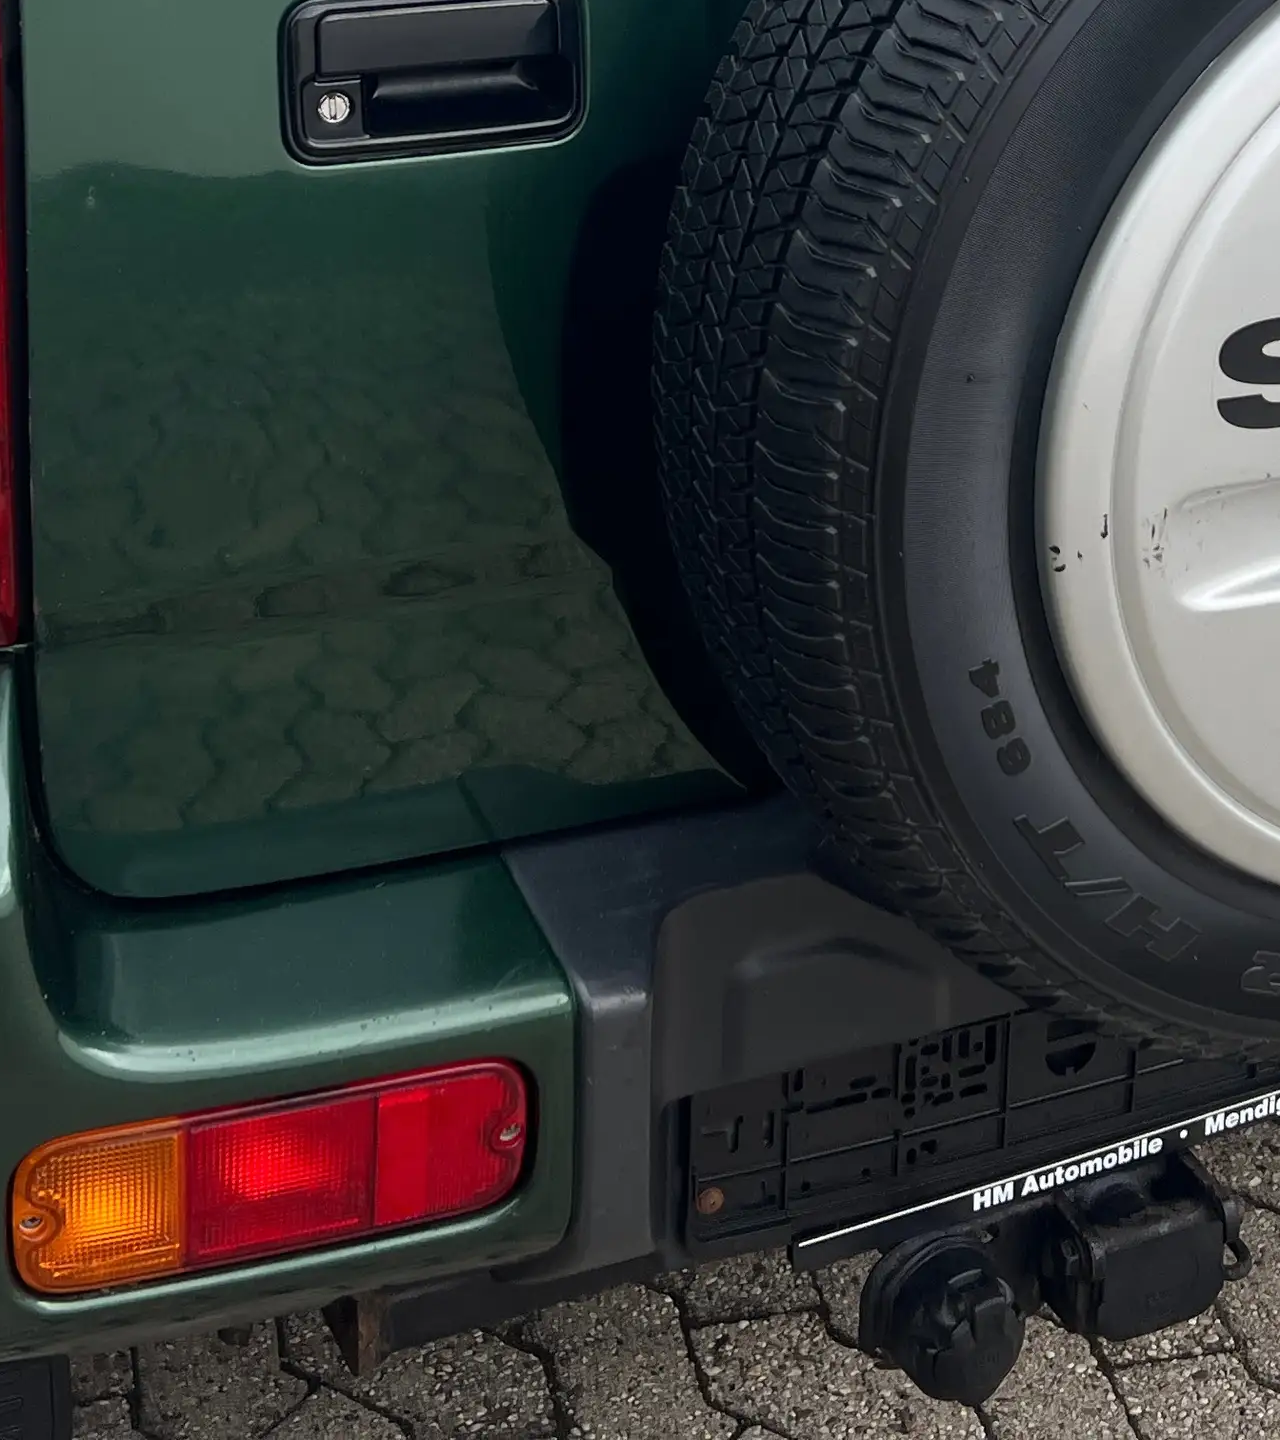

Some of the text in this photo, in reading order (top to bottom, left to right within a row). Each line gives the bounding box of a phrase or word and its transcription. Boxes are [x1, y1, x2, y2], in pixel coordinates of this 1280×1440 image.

[967, 656, 1032, 777] 684
[1014, 813, 1202, 962] H/T
[972, 1181, 1015, 1212] HM
[1021, 1136, 1164, 1197] Automobile
